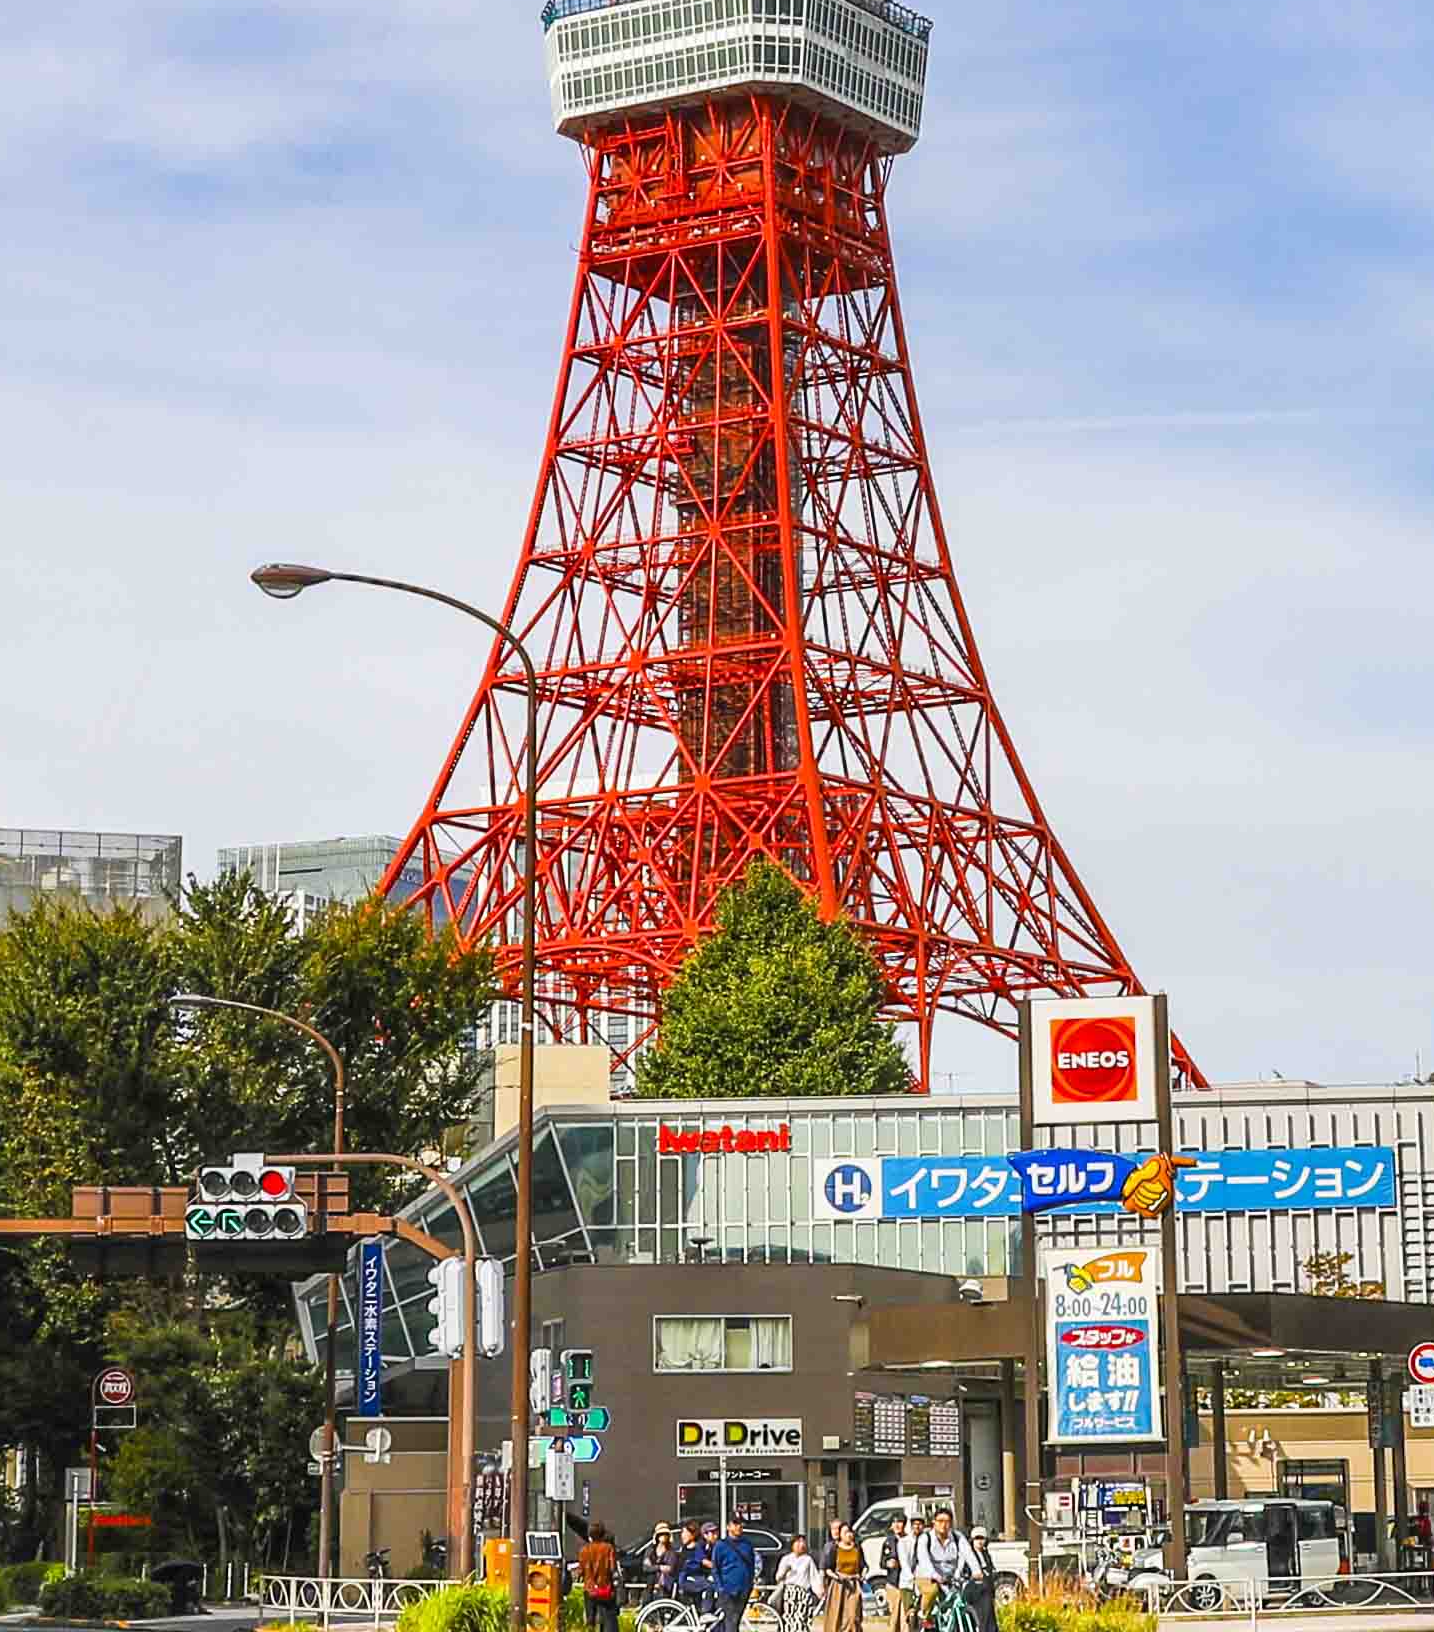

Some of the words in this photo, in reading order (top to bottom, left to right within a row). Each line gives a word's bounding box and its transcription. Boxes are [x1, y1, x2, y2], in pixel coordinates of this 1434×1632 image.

[1056, 1050, 1130, 1070] ENEOS
[658, 1123, 791, 1154] Iwatani
[1025, 1161, 1115, 1196] セルフ
[1097, 1259, 1136, 1279] フル
[363, 1255, 379, 1404] イワタニ水素ステーション
[678, 1421, 718, 1447] Dr.
[724, 1421, 801, 1447] Drive
